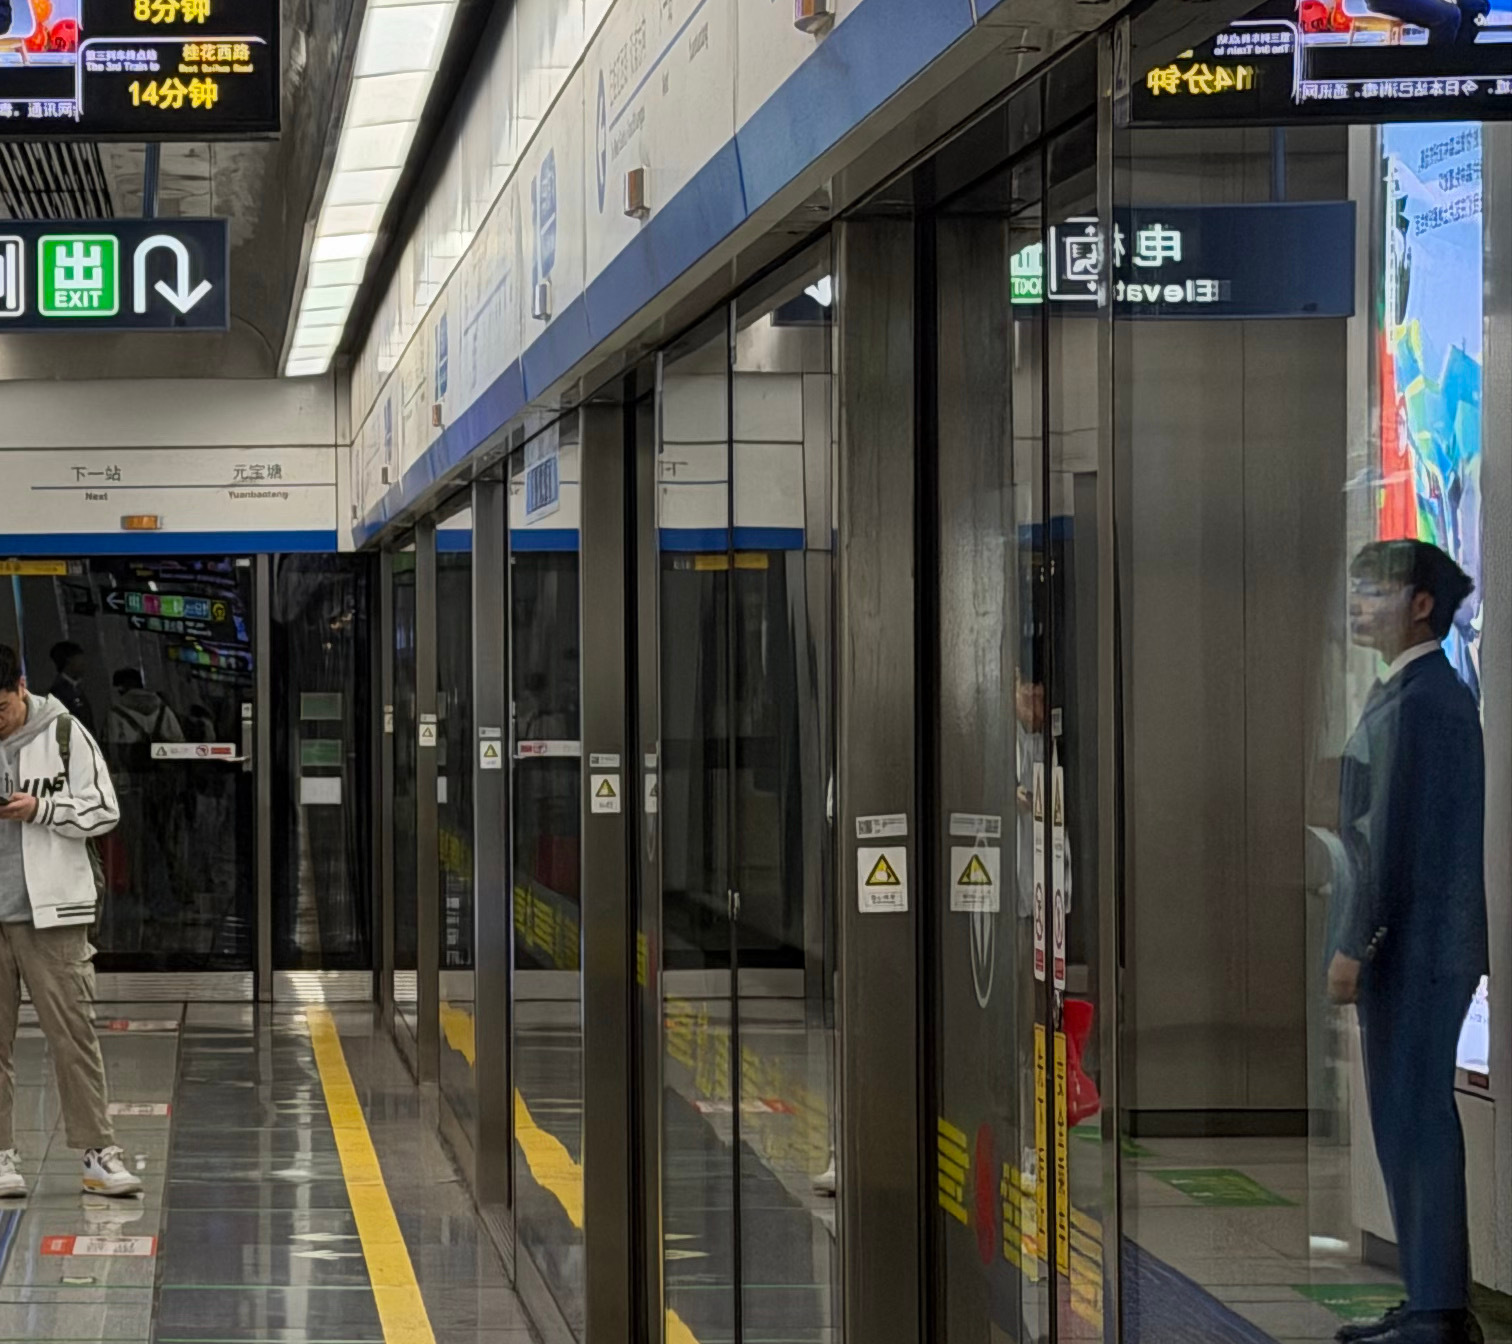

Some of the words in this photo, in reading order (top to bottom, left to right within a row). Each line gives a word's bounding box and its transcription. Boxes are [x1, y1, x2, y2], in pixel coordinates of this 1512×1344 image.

[128, 77, 219, 110] 14分钟
[54, 291, 103, 308] EXIT
[70, 464, 122, 482] 下一站
[232, 463, 283, 481] 元宝塘
[84, 491, 109, 501] Next
